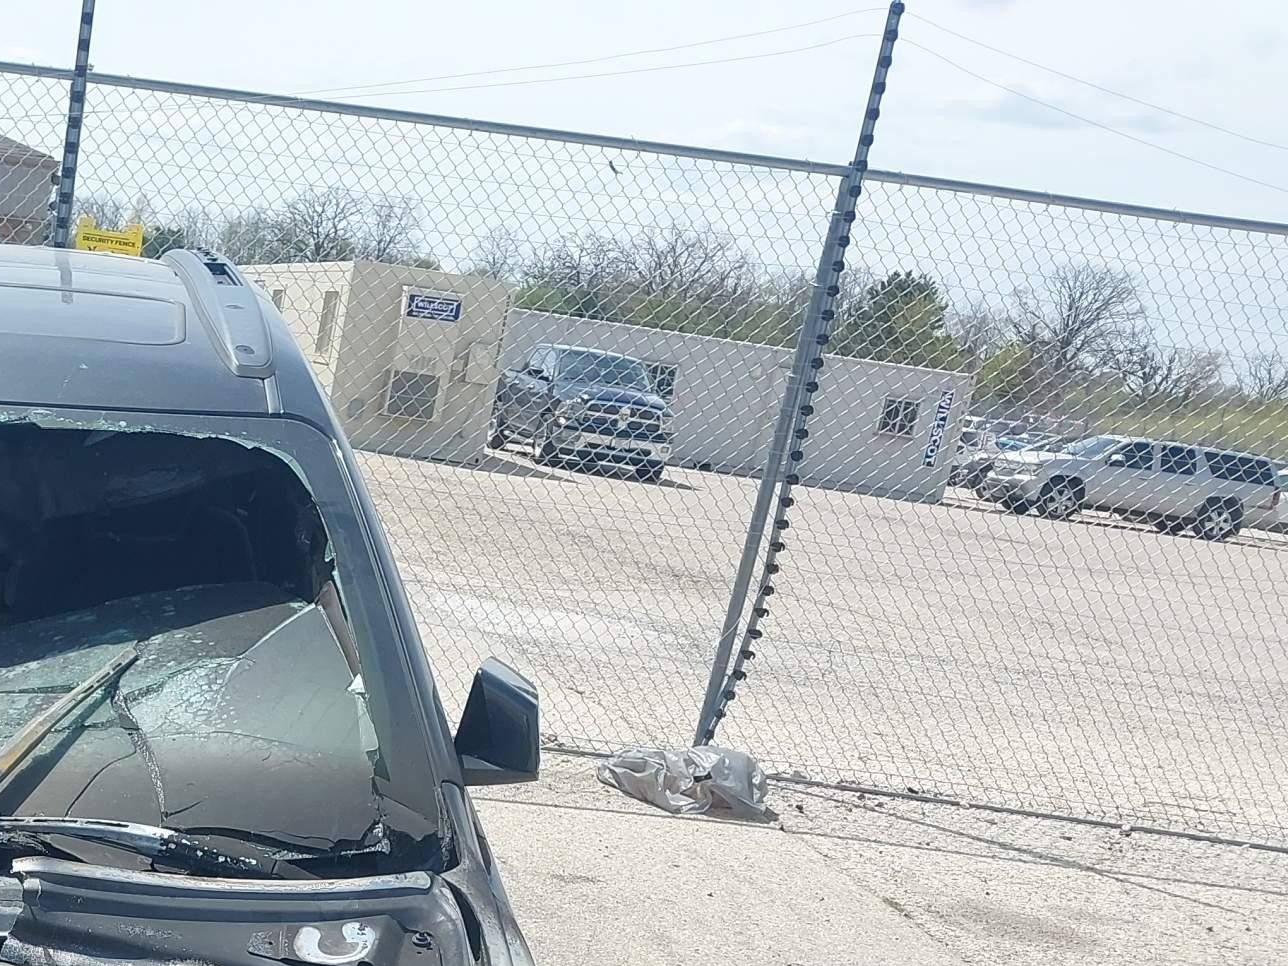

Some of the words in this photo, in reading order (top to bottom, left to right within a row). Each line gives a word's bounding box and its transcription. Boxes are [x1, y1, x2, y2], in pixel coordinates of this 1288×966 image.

[82, 235, 114, 245] SECURITY
[115, 240, 136, 248] FENCE
[925, 392, 952, 465] WILLSCOT
